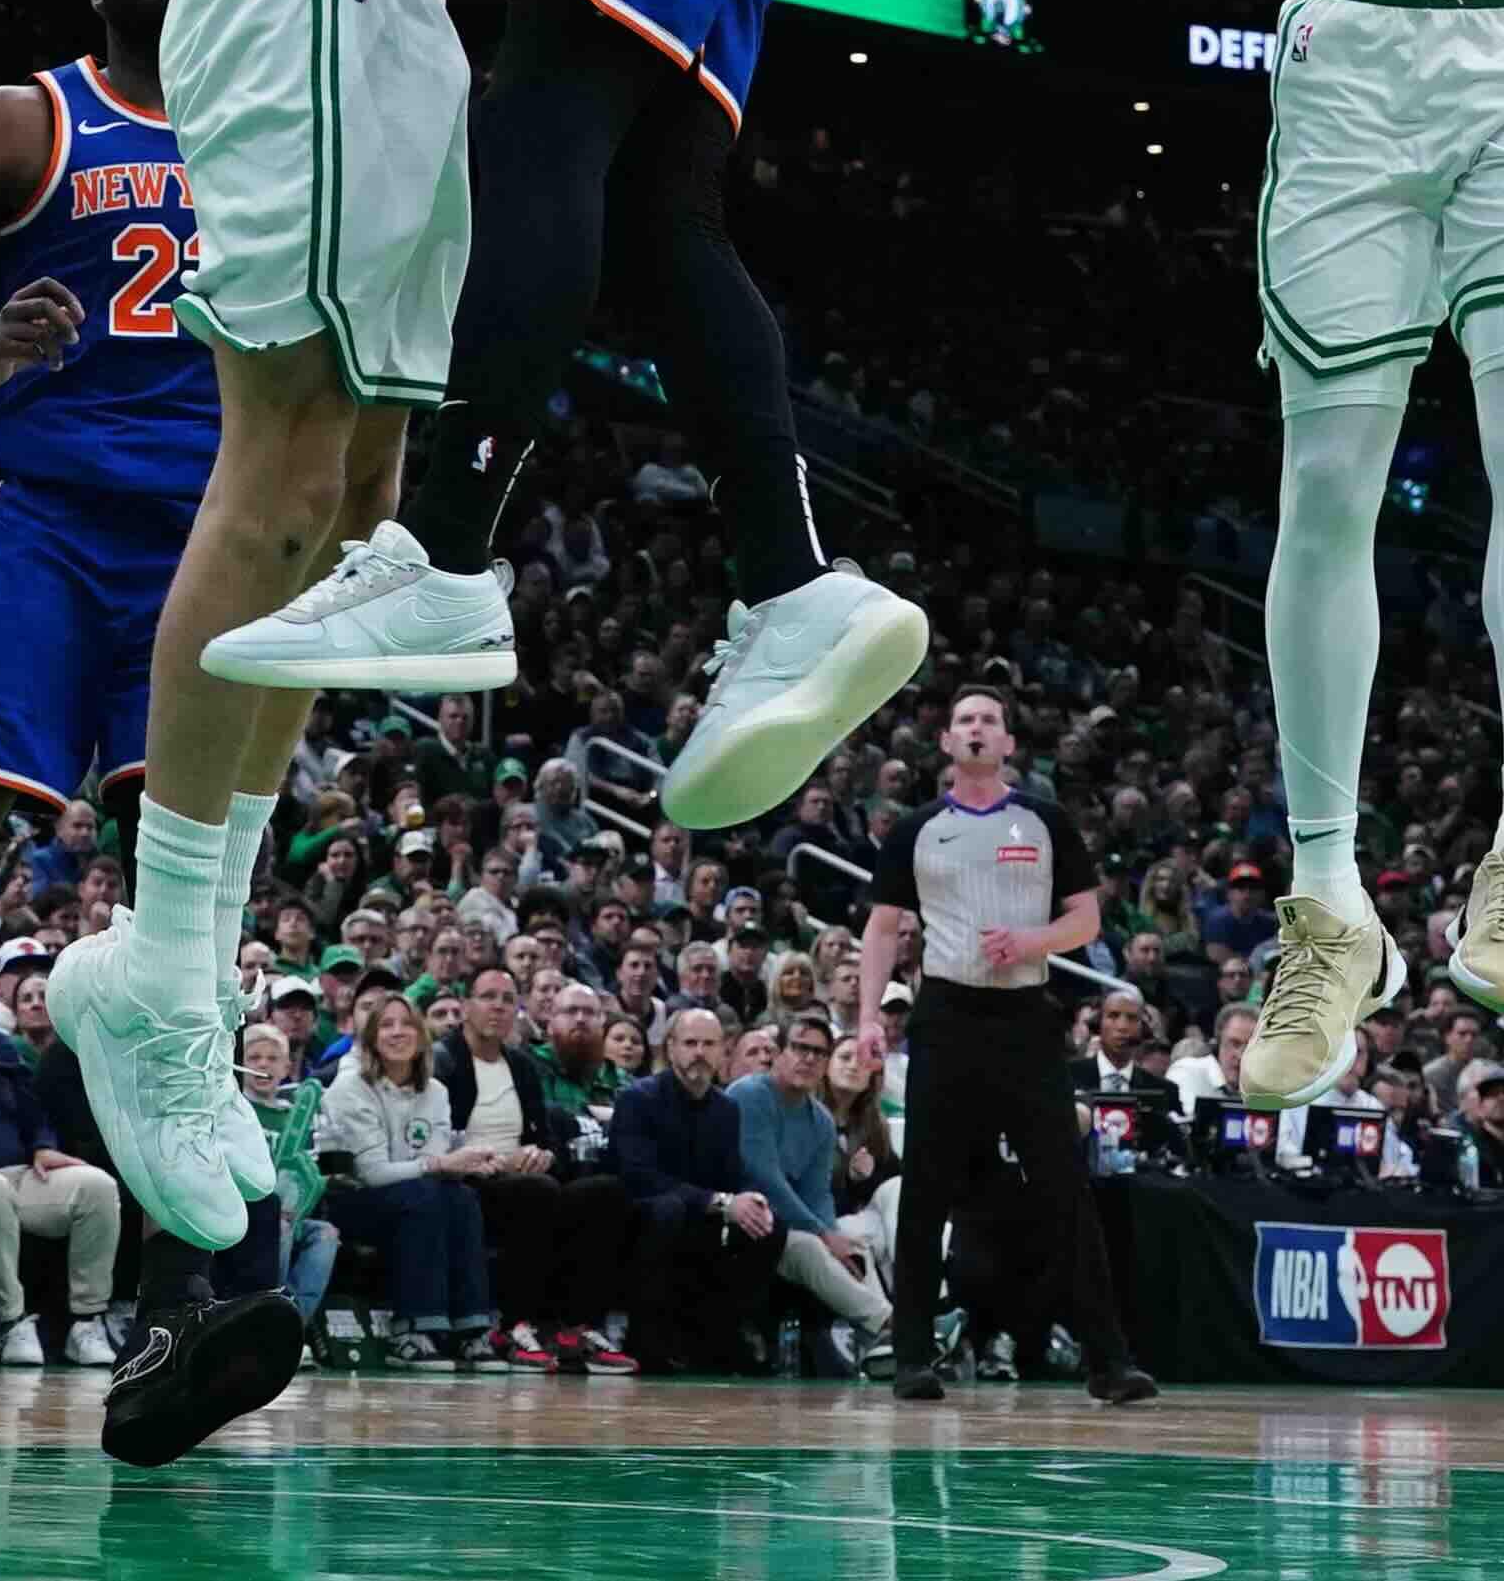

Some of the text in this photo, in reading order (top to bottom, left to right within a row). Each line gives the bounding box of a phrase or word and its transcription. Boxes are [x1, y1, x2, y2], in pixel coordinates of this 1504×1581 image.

[71, 163, 168, 221] NEW
[1270, 1248, 1436, 1321] NBA TNT
